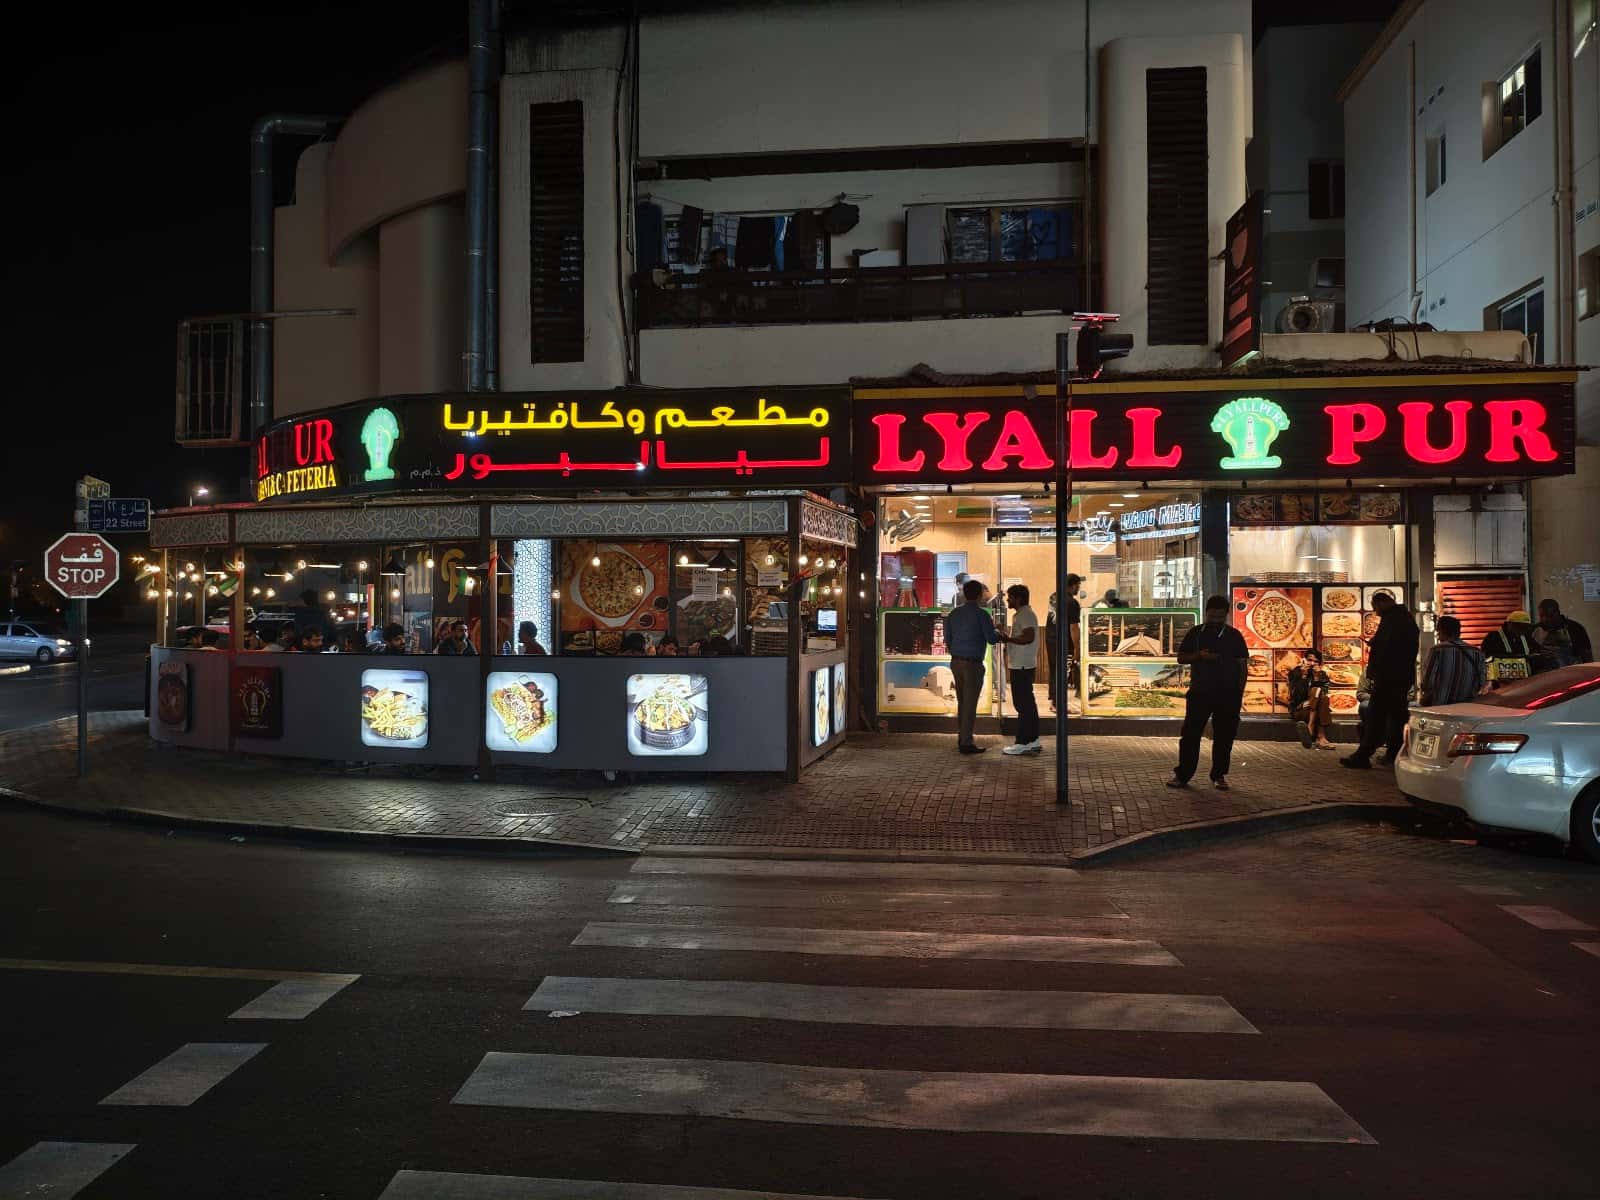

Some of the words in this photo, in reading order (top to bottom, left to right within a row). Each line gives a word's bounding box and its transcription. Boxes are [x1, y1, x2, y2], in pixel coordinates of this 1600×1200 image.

[443, 402, 646, 437] وكافتيريا
[655, 399, 830, 435] مطعم
[872, 407, 1182, 472] LYALL
[1324, 400, 1558, 465] PUR
[106, 518, 118, 528] 22
[120, 518, 146, 528] Street
[57, 567, 105, 583] STOP
